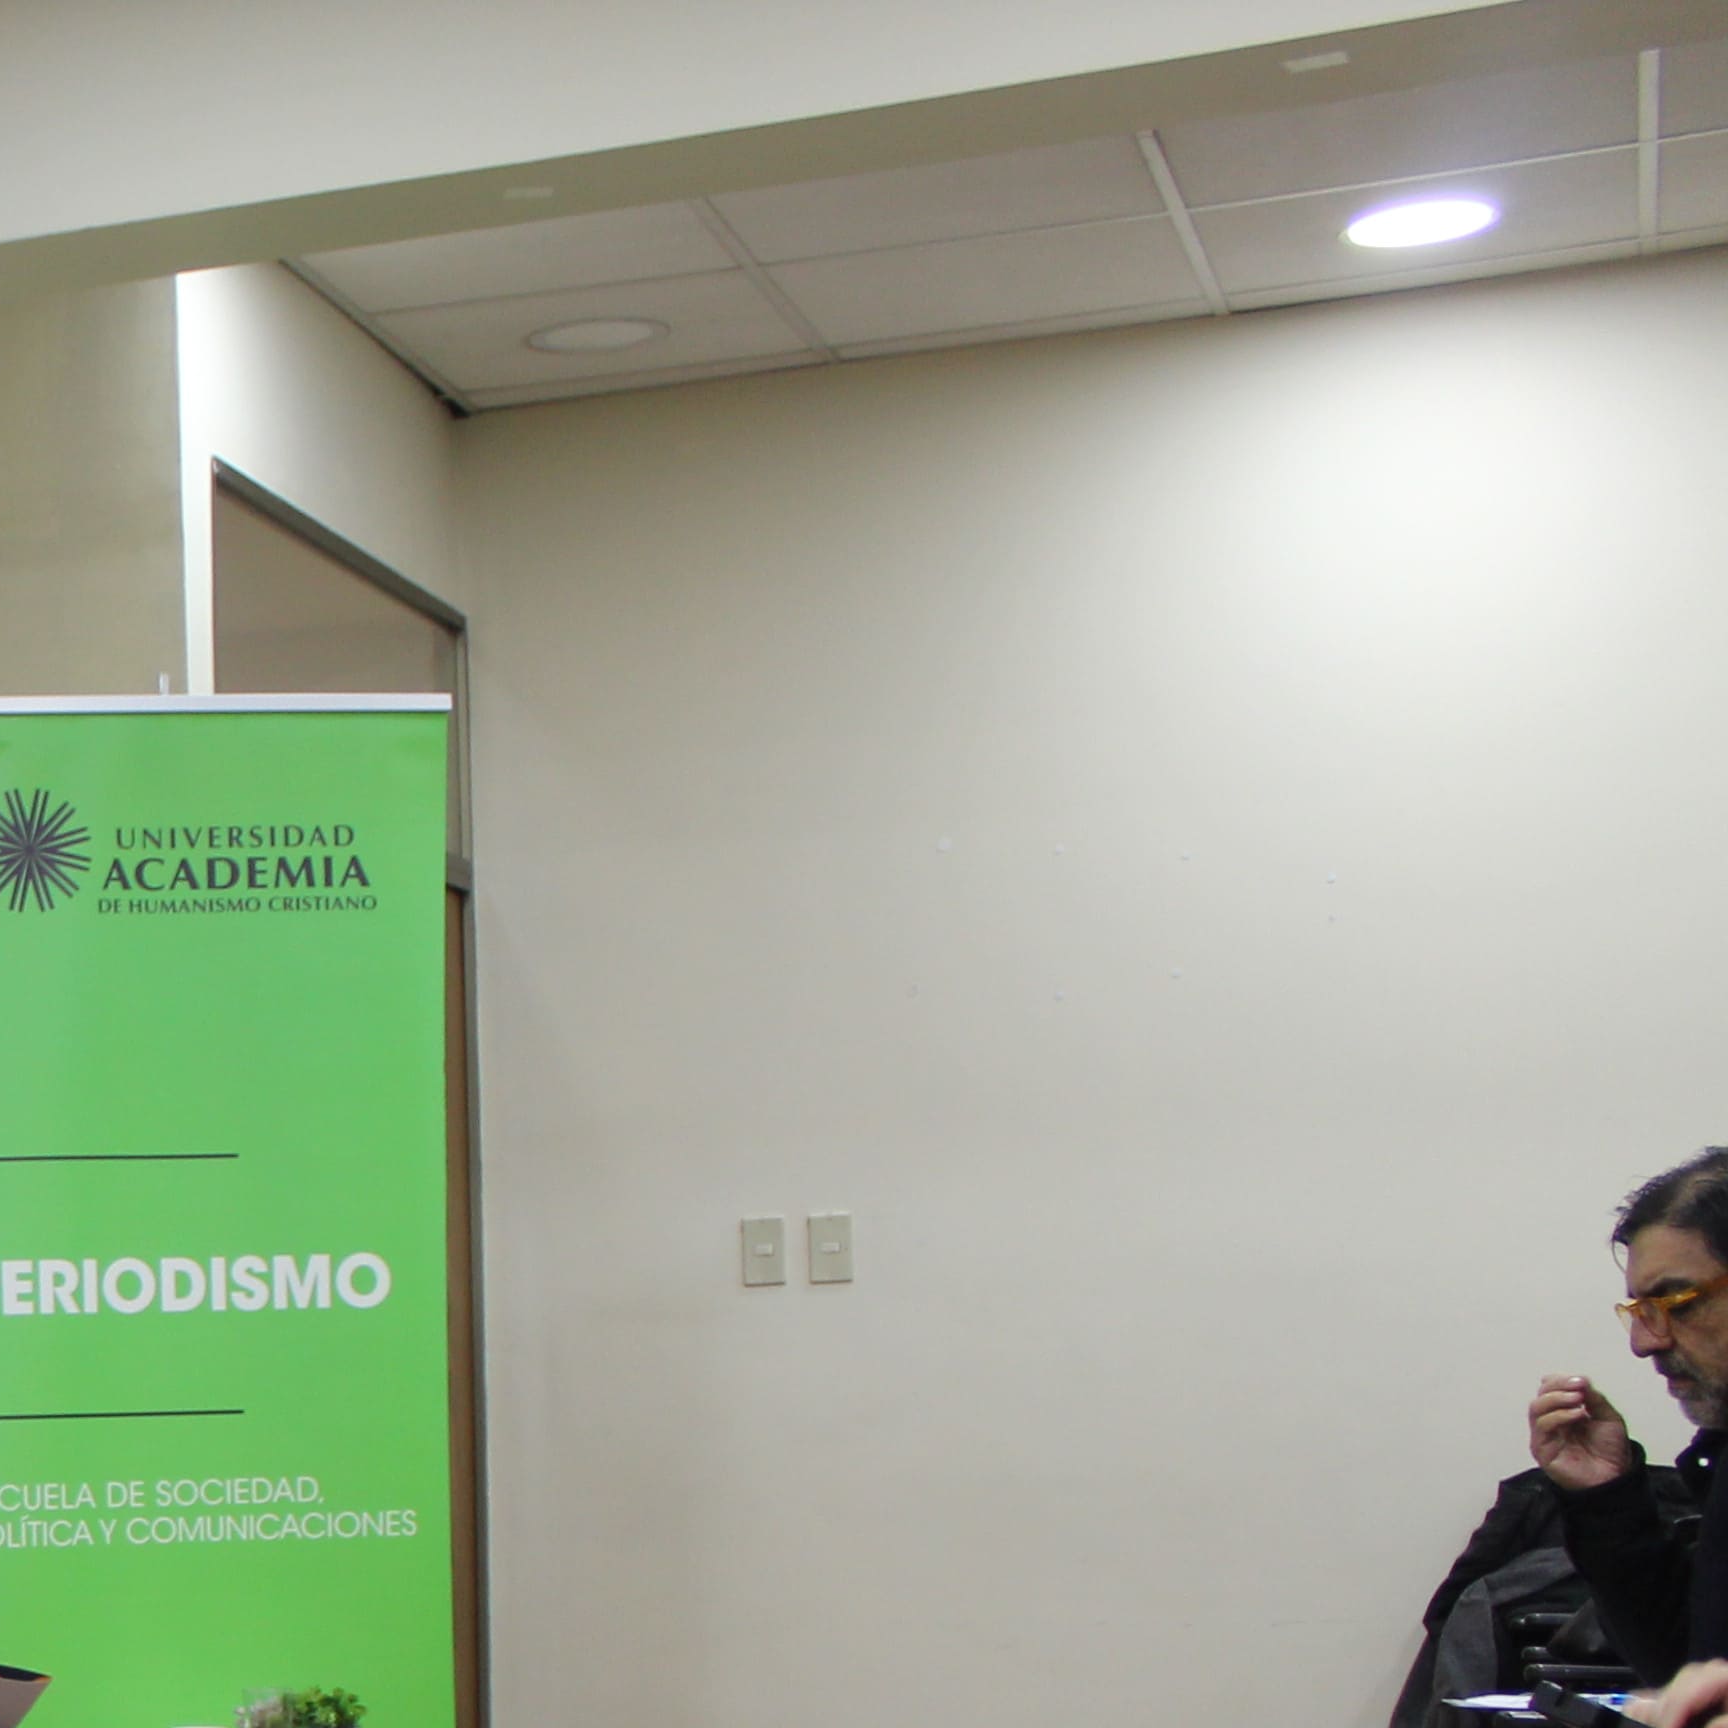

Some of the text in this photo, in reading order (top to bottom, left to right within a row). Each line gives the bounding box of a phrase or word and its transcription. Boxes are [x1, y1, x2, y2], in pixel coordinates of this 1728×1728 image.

[115, 824, 356, 850] UNIVERSIDAD
[102, 855, 371, 891] ACADEMIA
[97, 895, 379, 914] DE HUMANISMO CRISTIANO
[106, 1481, 145, 1509] DE
[155, 1476, 325, 1508] SOCIEDAD,
[98, 1519, 118, 1545] Y
[126, 1509, 418, 1544] COMUNICACIONES
